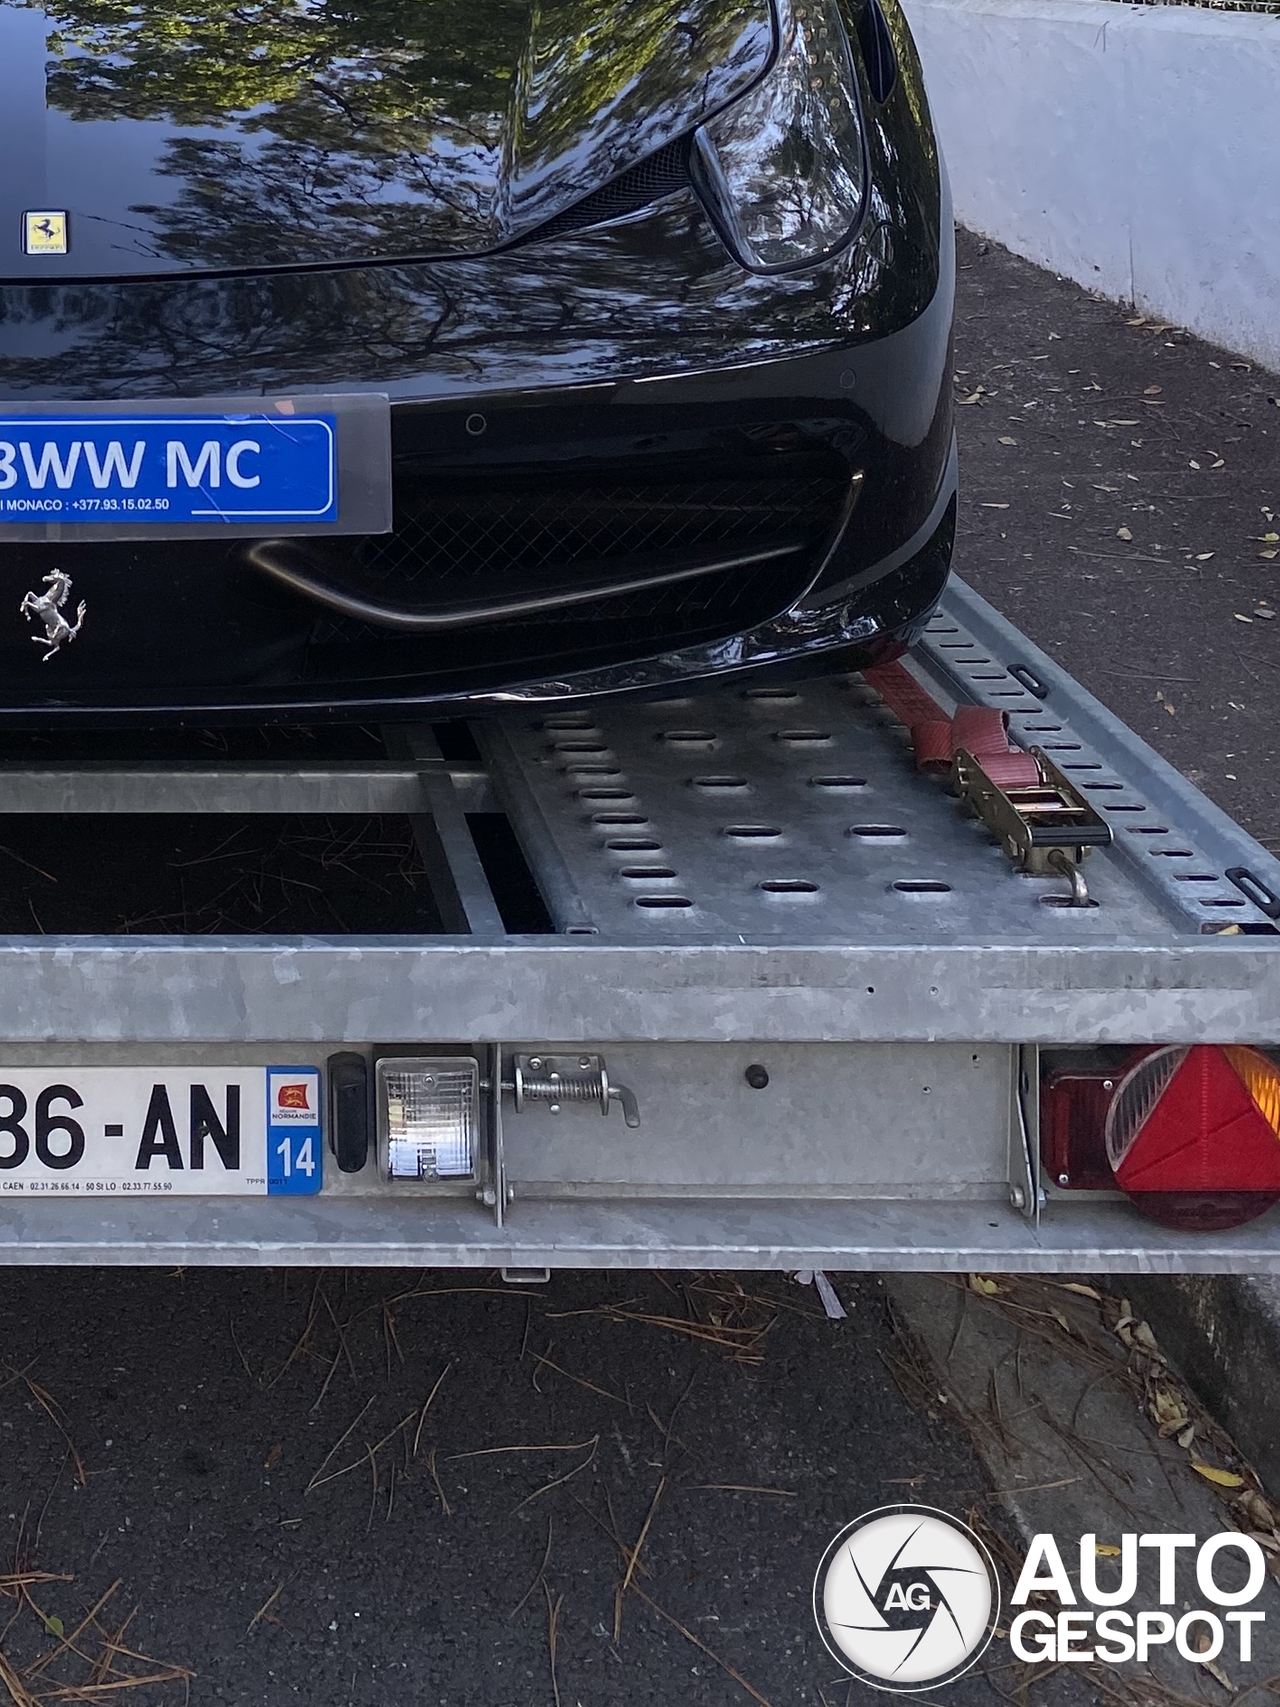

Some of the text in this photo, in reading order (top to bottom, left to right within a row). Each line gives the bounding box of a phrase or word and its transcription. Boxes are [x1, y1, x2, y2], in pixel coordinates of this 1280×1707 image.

[166, 440, 261, 488] MC
[6, 499, 63, 511] MONACO
[72, 498, 170, 511] +377.93.15.02.50
[277, 1137, 316, 1177] 14
[2, 1182, 24, 1190] CAEN
